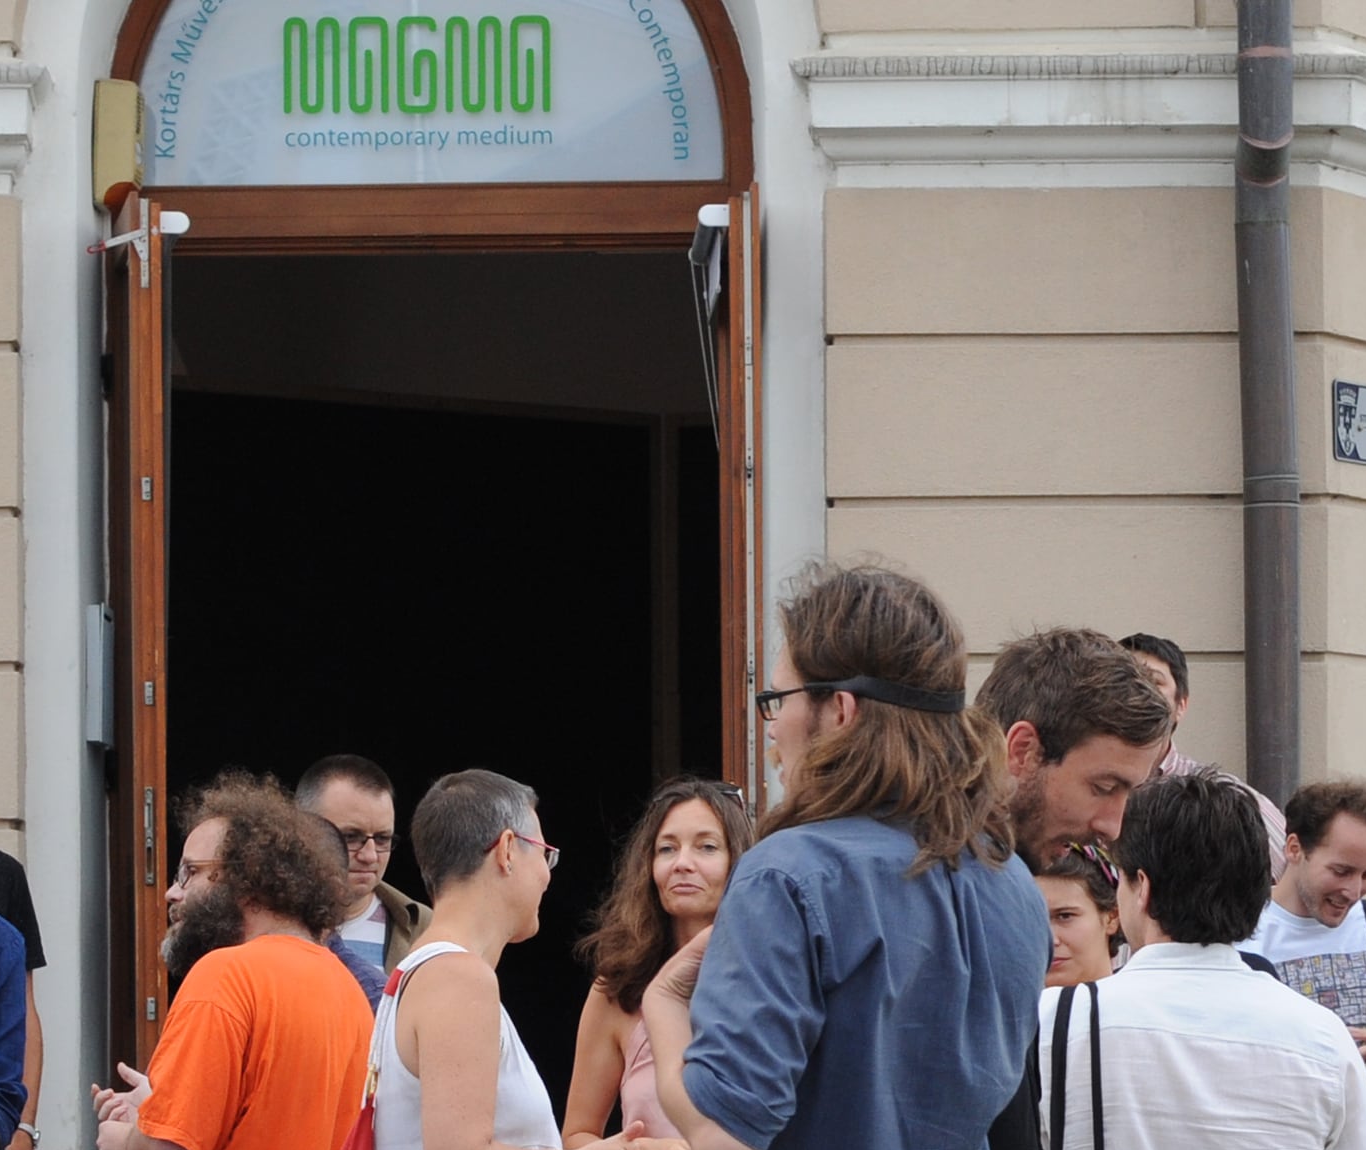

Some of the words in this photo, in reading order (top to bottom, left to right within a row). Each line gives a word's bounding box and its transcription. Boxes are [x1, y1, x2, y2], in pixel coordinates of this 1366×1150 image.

[154, 70, 186, 159] Kortárs
[284, 129, 450, 151] contemporary
[457, 125, 554, 146] medium
